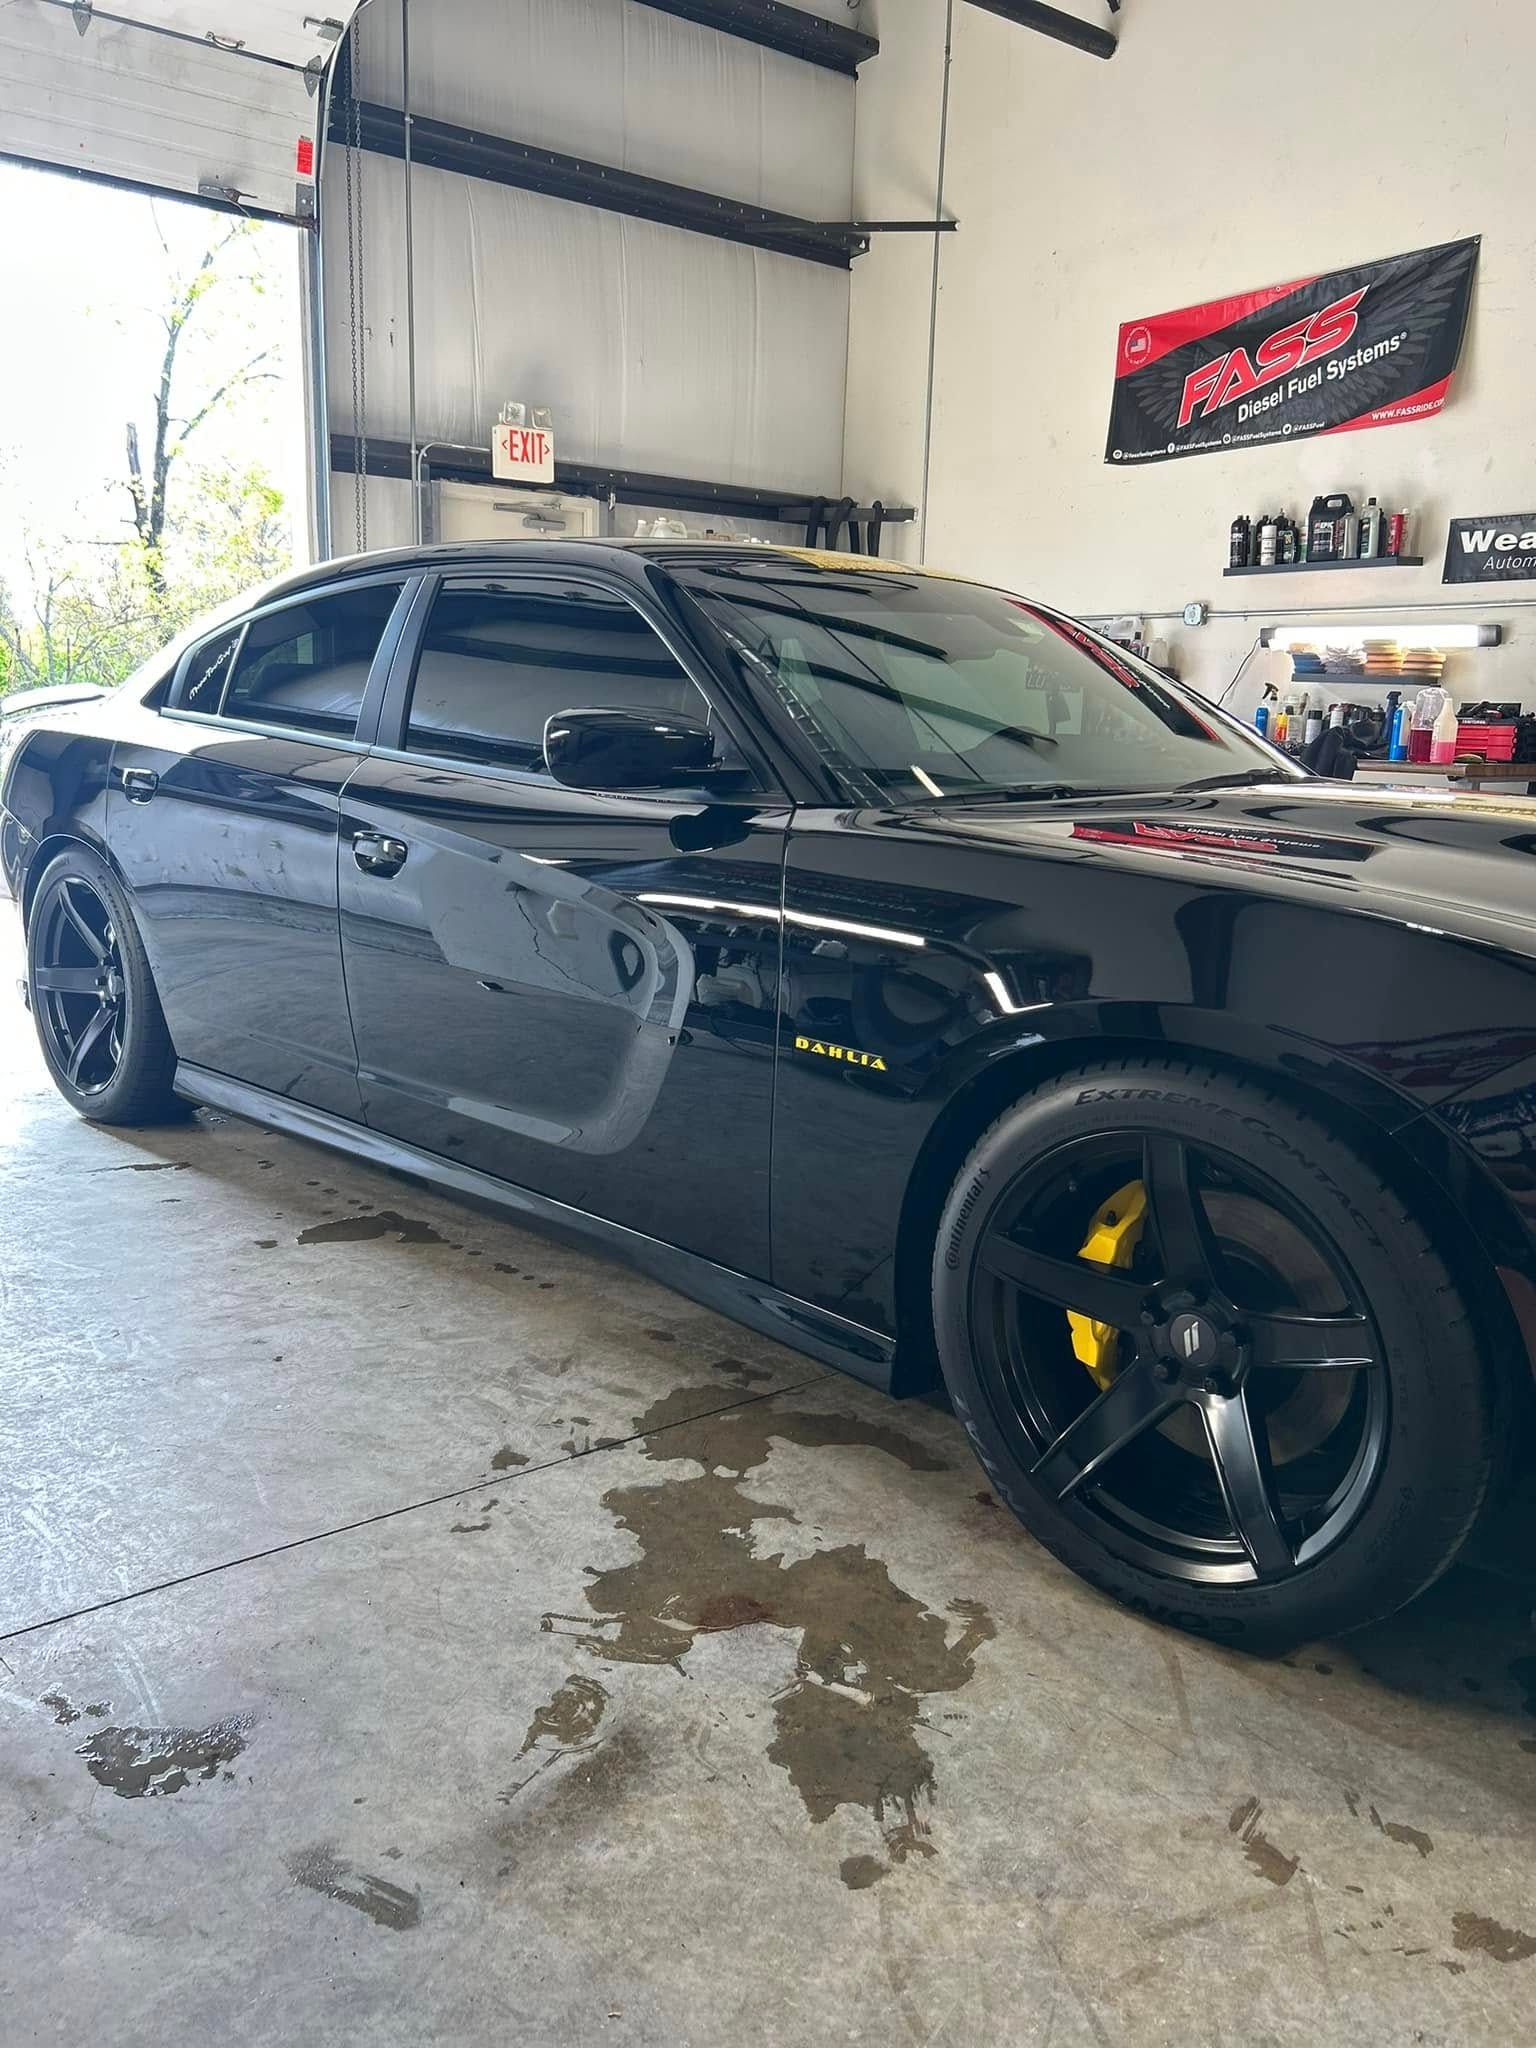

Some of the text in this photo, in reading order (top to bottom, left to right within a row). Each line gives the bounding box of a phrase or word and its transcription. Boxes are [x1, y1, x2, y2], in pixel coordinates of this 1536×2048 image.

[1177, 284, 1371, 429] FASS
[1237, 385, 1283, 423] Diesel
[1287, 366, 1322, 399] Fuel
[509, 429, 545, 465] EXIT
[795, 1036, 887, 1072] DAHLIA
[945, 1177, 985, 1271] Continental
